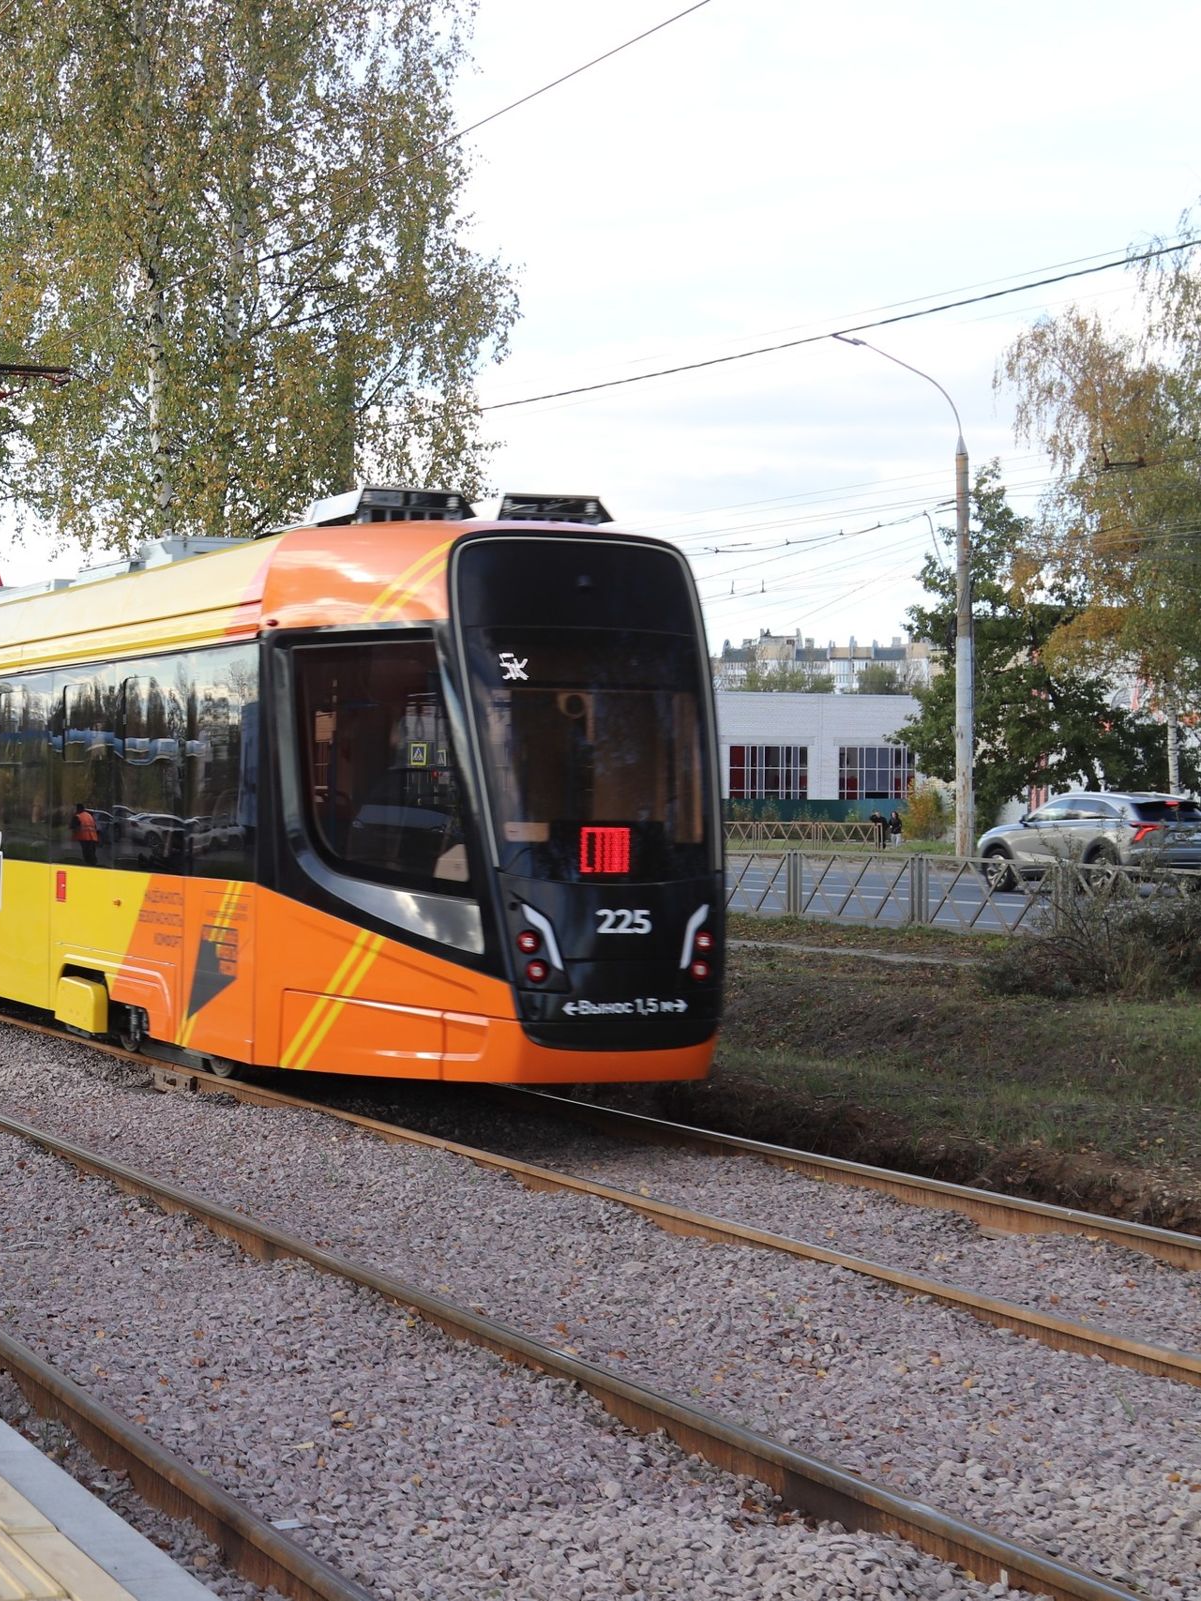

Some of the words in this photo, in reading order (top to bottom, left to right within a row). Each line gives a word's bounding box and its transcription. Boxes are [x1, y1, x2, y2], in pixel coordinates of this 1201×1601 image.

[594, 908, 653, 935] 225
[577, 999, 634, 1015] Вынос
[635, 997, 659, 1016] 1,5
